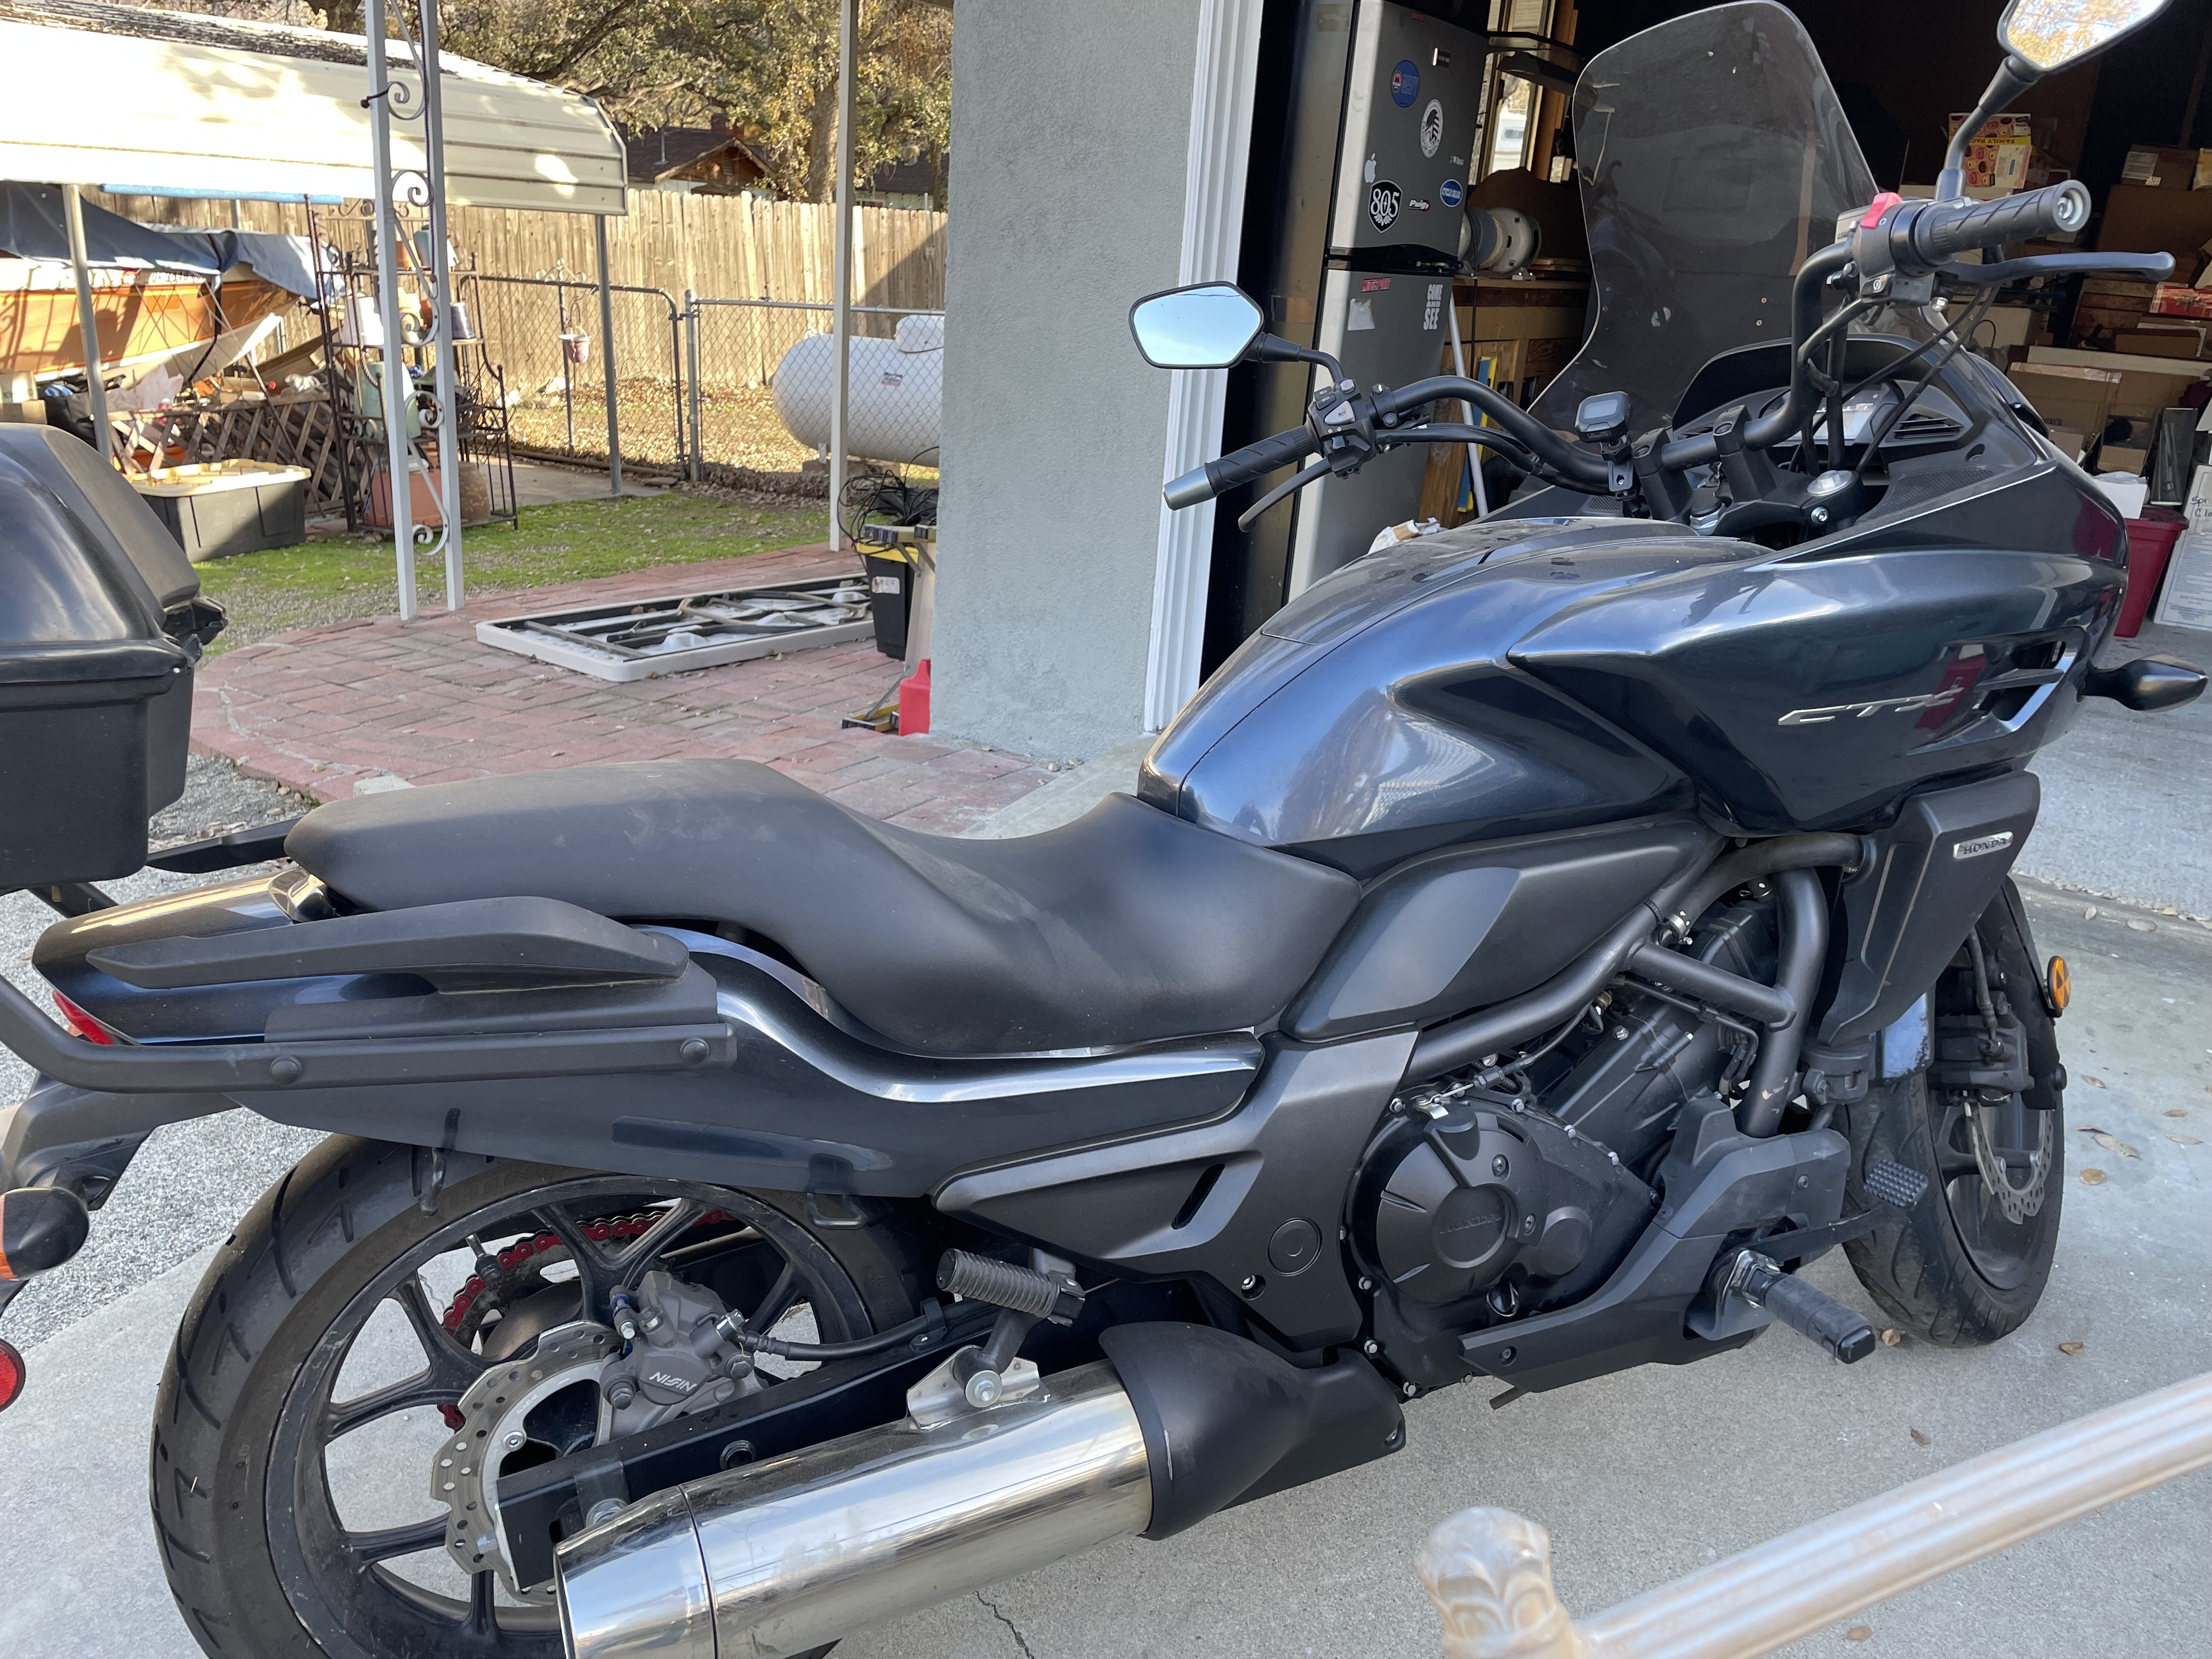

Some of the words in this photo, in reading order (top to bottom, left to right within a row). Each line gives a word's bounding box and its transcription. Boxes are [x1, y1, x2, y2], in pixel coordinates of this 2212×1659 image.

[1370, 188, 1400, 218] 805
[1423, 308, 1440, 330] SEE
[1963, 838, 2006, 855] HONDA
[1440, 1213, 1502, 1234] HONDA
[648, 1372, 697, 1392] NISSIN
